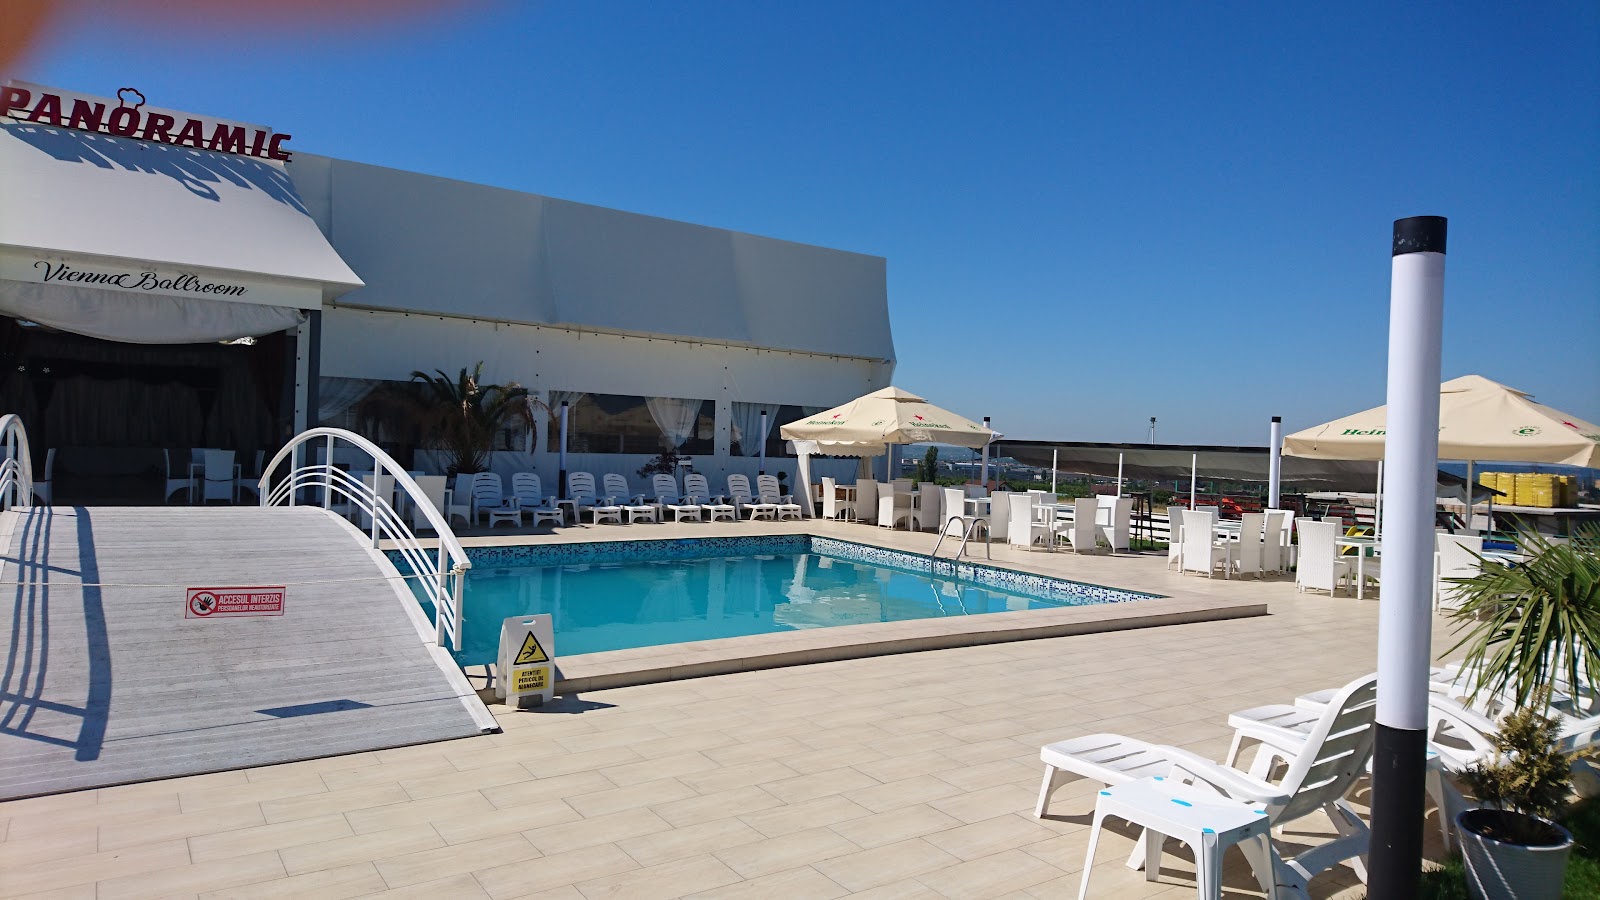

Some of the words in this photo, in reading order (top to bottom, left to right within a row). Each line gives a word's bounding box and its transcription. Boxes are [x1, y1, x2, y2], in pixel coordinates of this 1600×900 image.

[0, 85, 292, 161] PANORAMIC
[34, 260, 129, 287] Vienna
[120, 270, 248, 297] Ballroom
[219, 595, 249, 604] ACCESUL
[251, 594, 280, 603] INTERZIS
